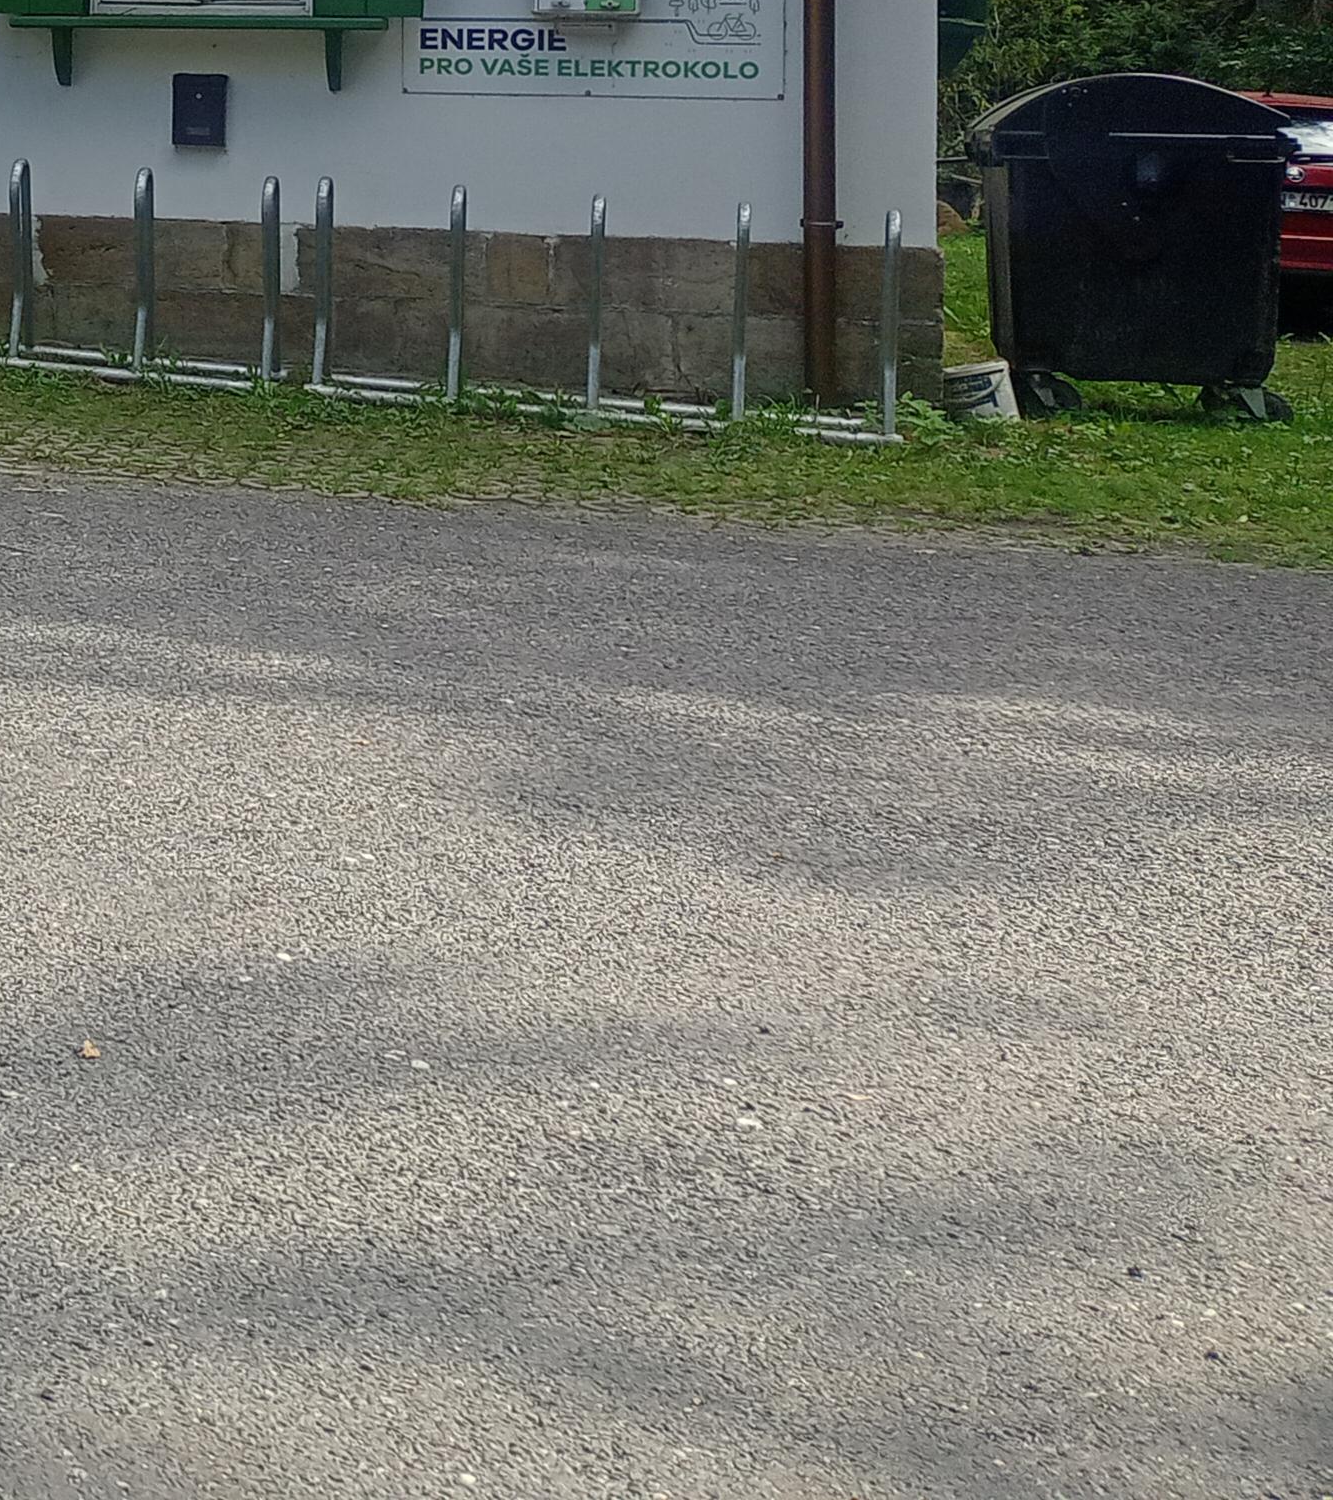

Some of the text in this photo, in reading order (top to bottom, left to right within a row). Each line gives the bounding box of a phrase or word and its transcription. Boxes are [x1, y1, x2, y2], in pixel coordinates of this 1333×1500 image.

[419, 28, 567, 52] ENERGIE
[419, 53, 760, 80] PRO VAŠE ELEKTROKOLO
